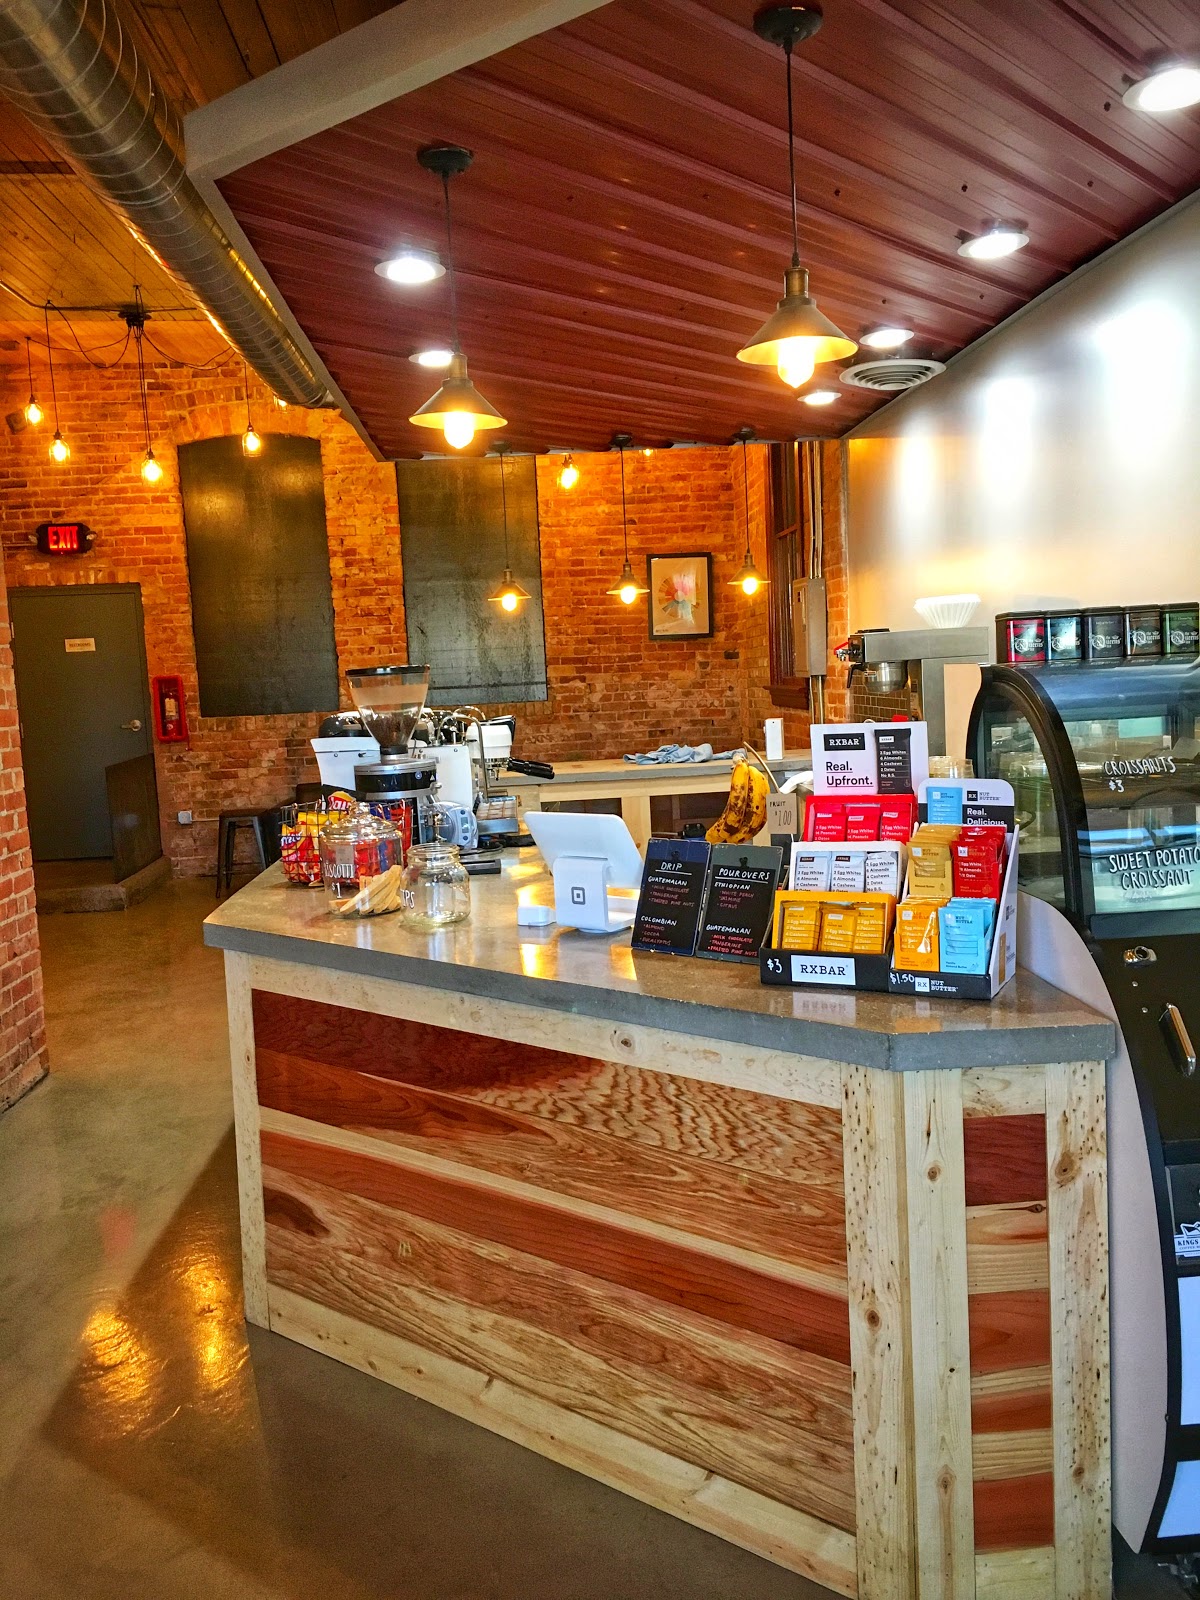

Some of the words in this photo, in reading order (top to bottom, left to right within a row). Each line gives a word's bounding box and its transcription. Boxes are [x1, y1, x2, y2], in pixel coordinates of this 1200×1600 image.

[48, 526, 78, 549] EXIT
[826, 761, 853, 771] Real.
[1104, 756, 1176, 776] CROISSANTS
[827, 776, 873, 787] Upfront.
[1109, 779, 1124, 792] $3
[660, 862, 682, 870] DRIP
[1109, 850, 1151, 873] SWEET
[648, 876, 687, 886] GUATEMALAN
[1122, 869, 1194, 890] CROISSANT
[332, 882, 342, 899] $1
[715, 882, 750, 890] ETHIOPIAN
[641, 916, 677, 926] COLOMBIAN
[706, 924, 751, 934] GUATEMALAN
[712, 940, 742, 948] TANGERINE
[767, 958, 782, 973] $3
[800, 964, 846, 975] RXBAR
[890, 972, 914, 984] $1.50
[1177, 1239, 1199, 1247] KINGS
